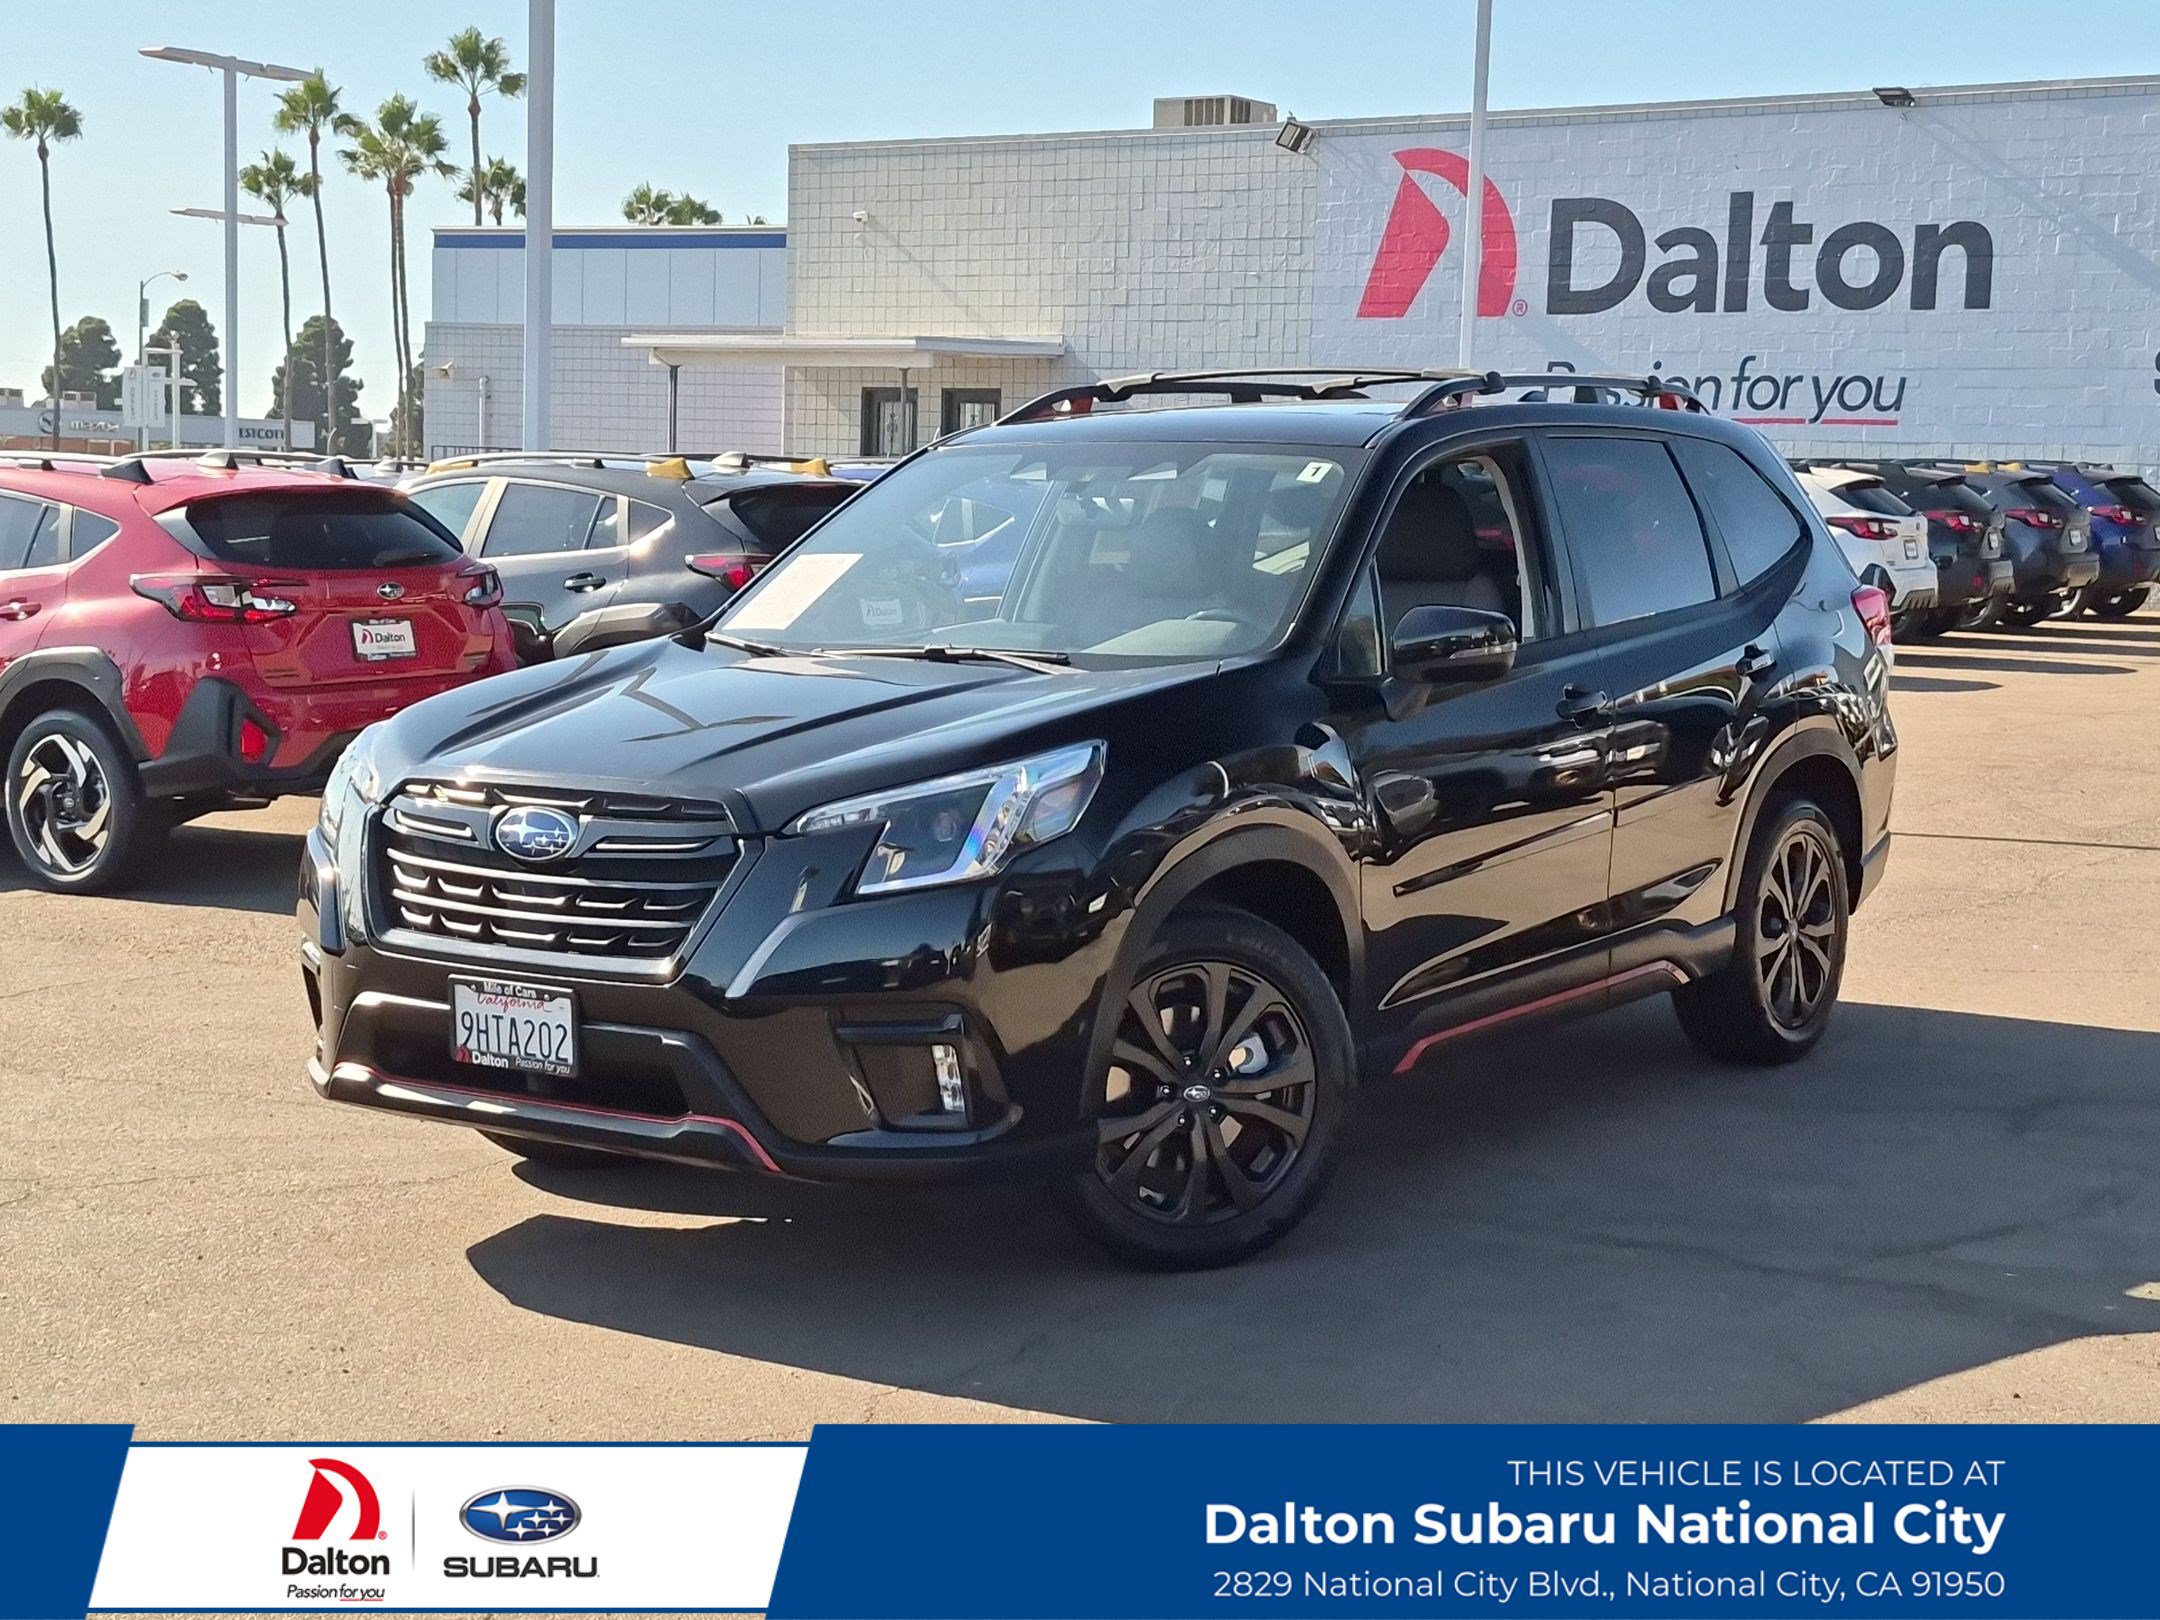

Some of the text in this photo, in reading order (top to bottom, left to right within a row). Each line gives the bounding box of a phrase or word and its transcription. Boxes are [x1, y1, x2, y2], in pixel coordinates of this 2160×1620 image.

[1546, 191, 1994, 315] Dalton
[1731, 355, 1804, 411] for
[1808, 375, 1907, 424] you
[375, 632, 406, 644] Dalton
[504, 984, 514, 996] of
[515, 985, 537, 999] Cars
[461, 1010, 569, 1063] 9HTA202
[472, 1051, 509, 1069] Dalton
[516, 1056, 570, 1074] Passion for you
